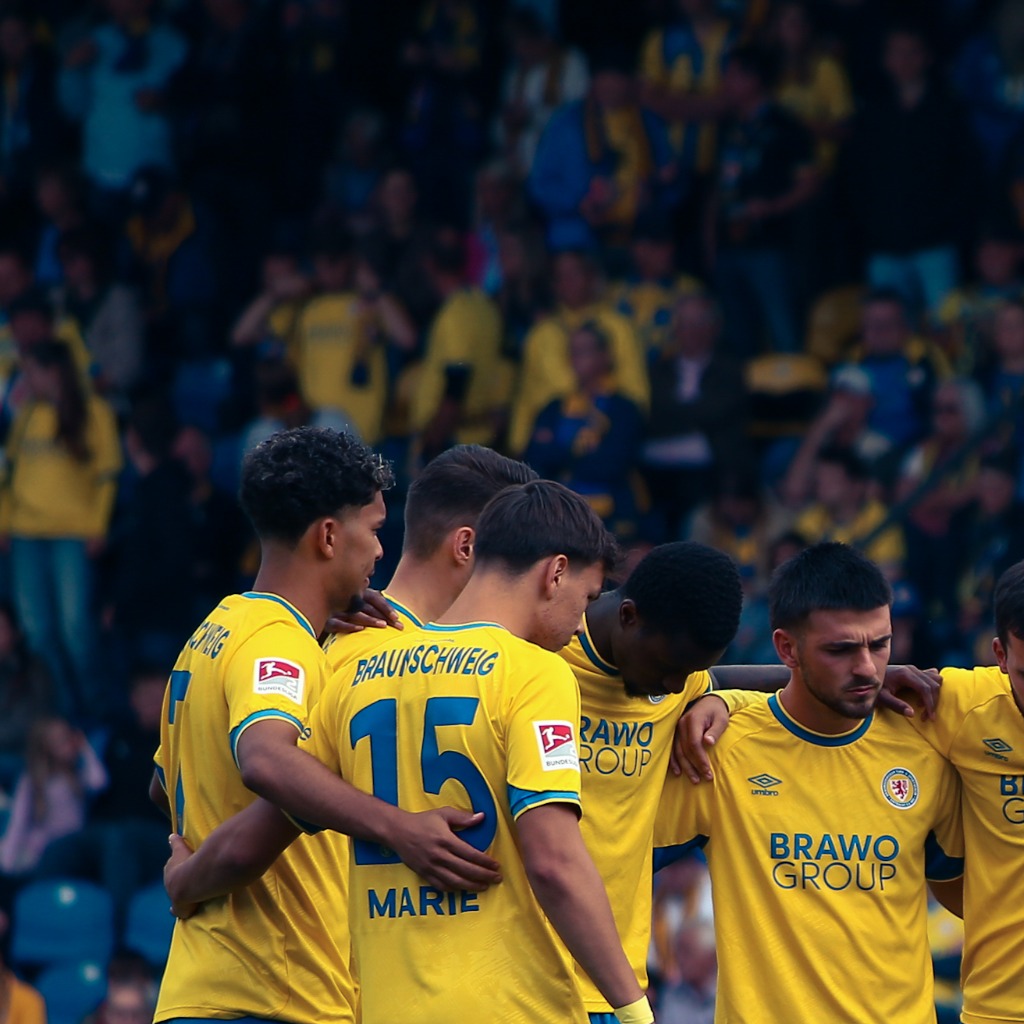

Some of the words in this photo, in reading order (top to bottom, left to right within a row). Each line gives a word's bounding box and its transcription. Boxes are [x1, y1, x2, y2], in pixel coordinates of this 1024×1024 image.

[351, 644, 499, 687] BRAUNSCHWEIG
[350, 697, 498, 865] 15
[770, 833, 900, 862] BRAWO
[772, 861, 897, 891] GROUP
[368, 885, 480, 919] MARIE
